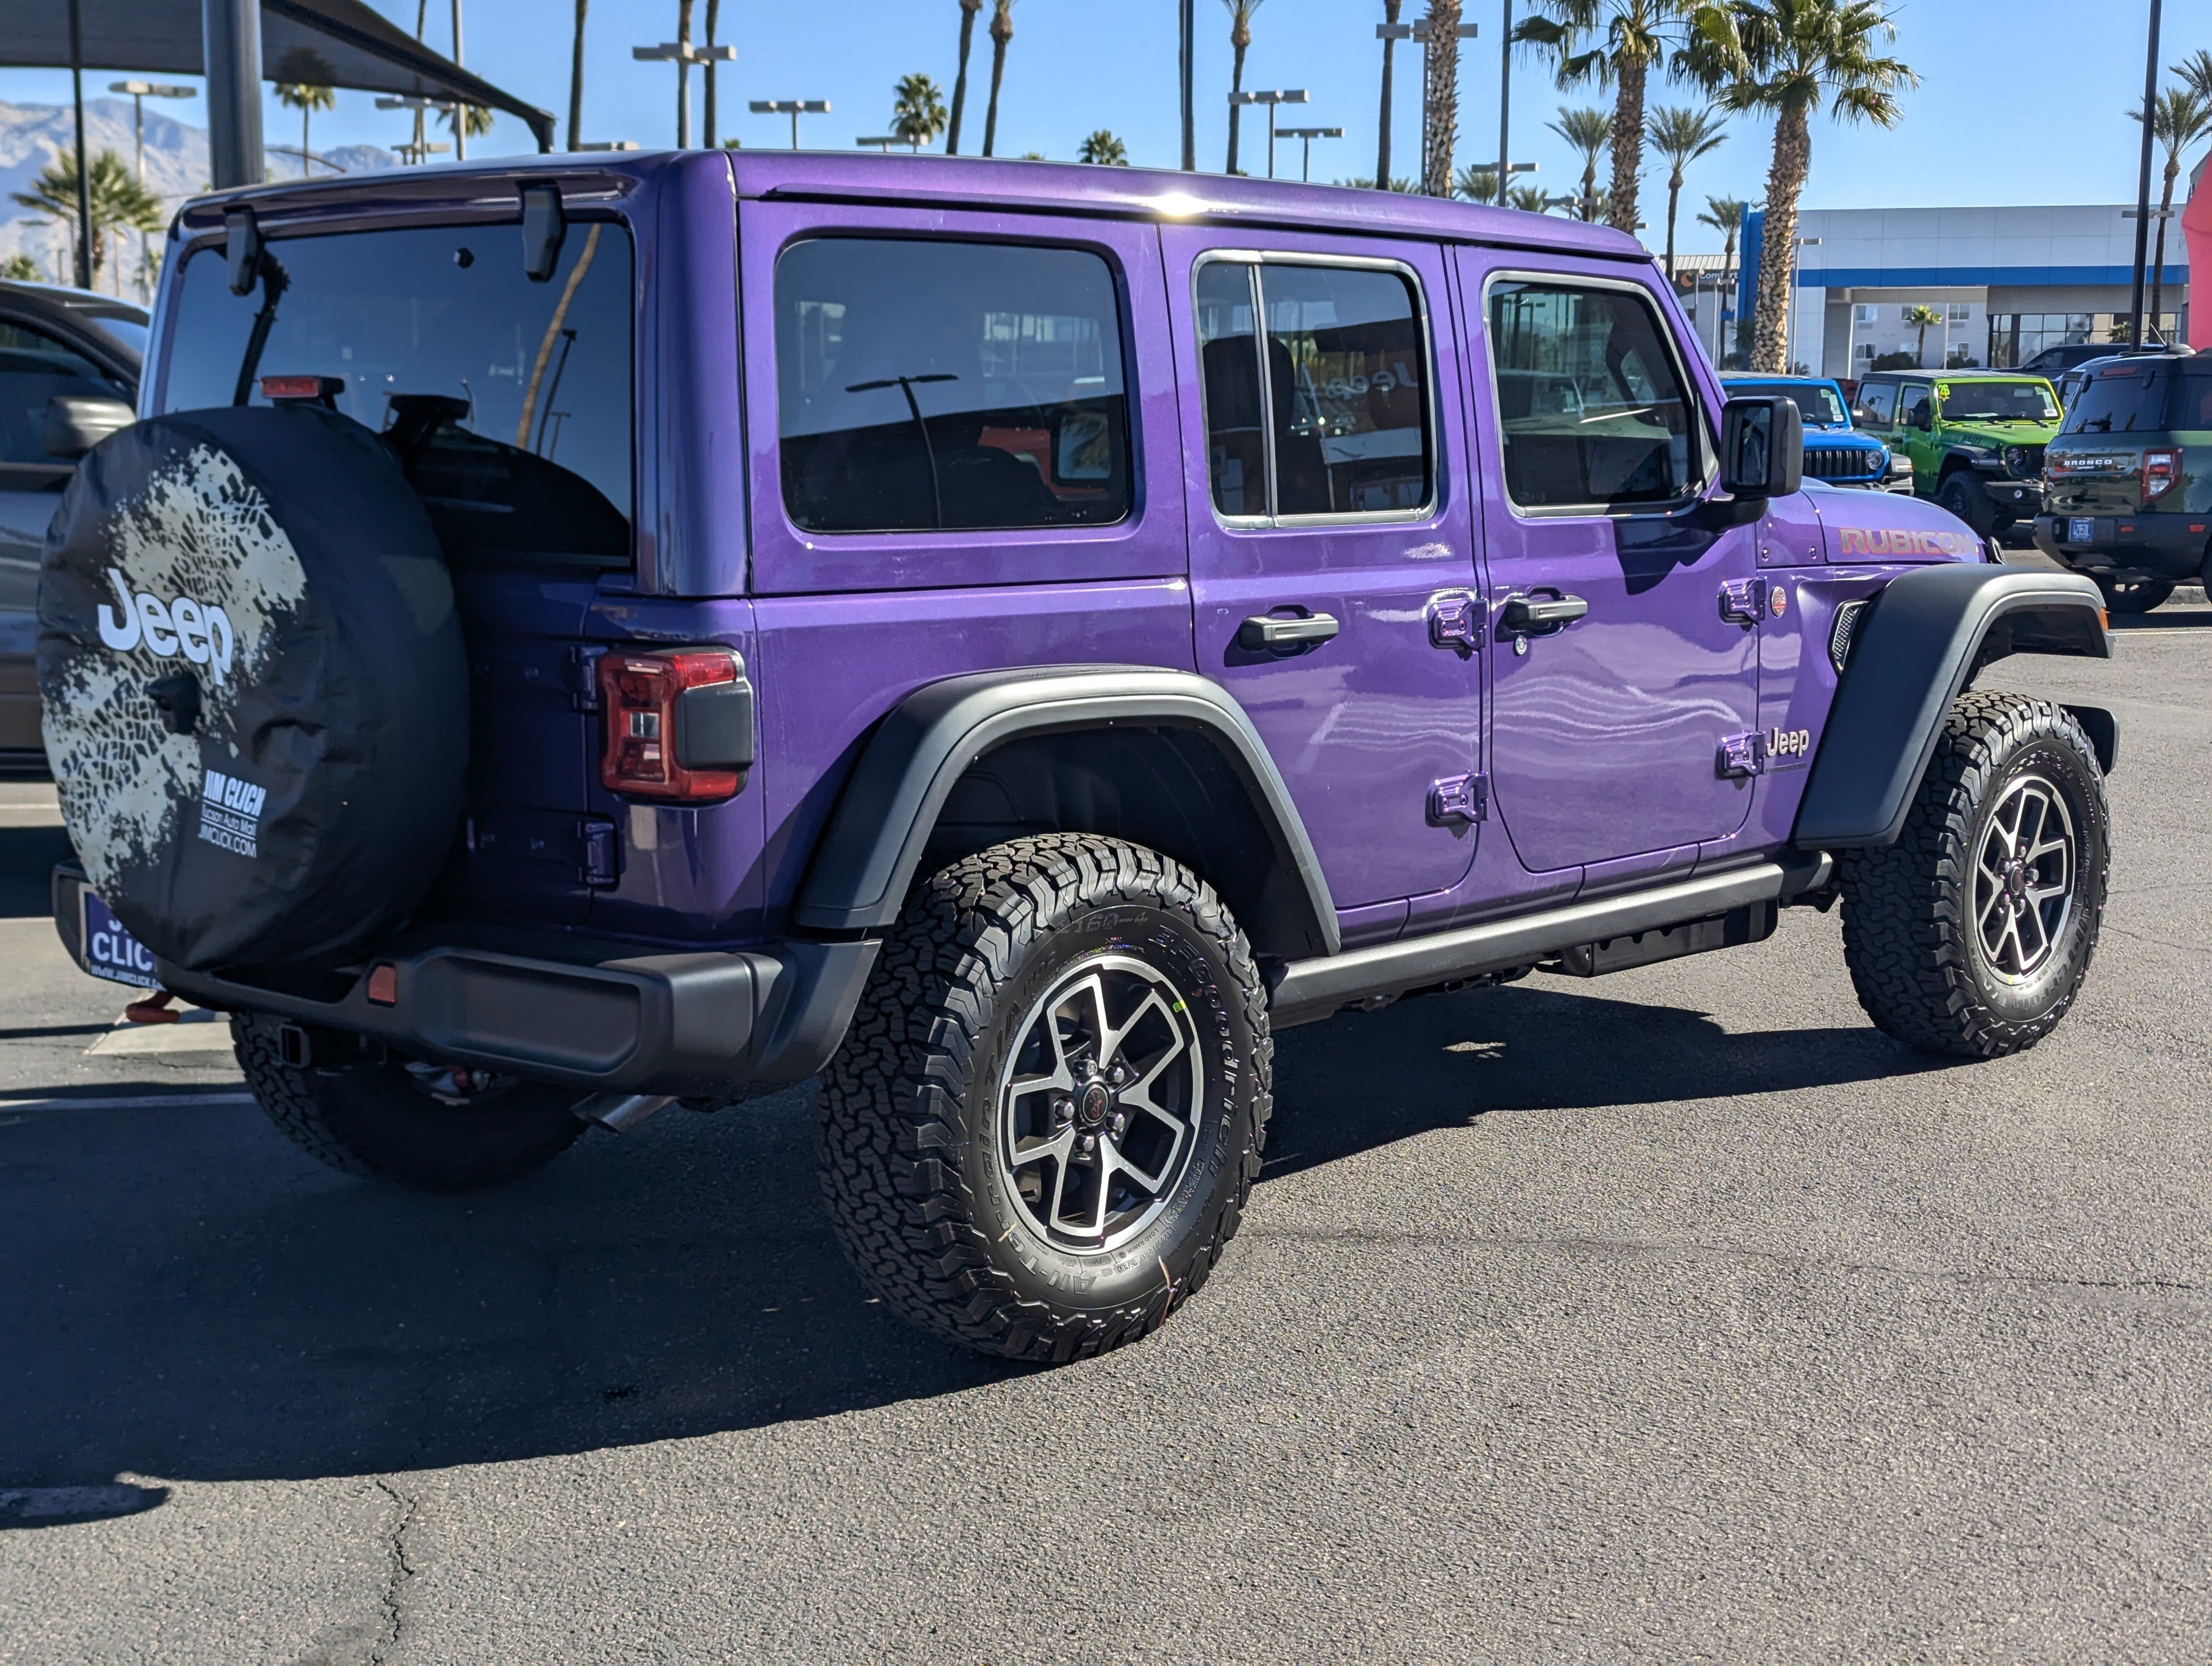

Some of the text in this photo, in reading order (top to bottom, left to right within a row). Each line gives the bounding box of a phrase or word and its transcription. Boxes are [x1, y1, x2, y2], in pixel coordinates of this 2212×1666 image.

[1699, 270, 1738, 279] Comfrt
[1839, 528, 1979, 555] RUBICON
[98, 567, 234, 687] Jeep
[1766, 726, 1810, 758] Jeep
[203, 769, 267, 817] JIM CLICK
[198, 823, 257, 857] JIMCLICK.COM
[93, 931, 153, 972] CLIC
[1147, 924, 1239, 1179] BFGoodrich
[979, 1096, 1097, 1296] All-Terrain
[1146, 1228, 1160, 1242] LOAD
